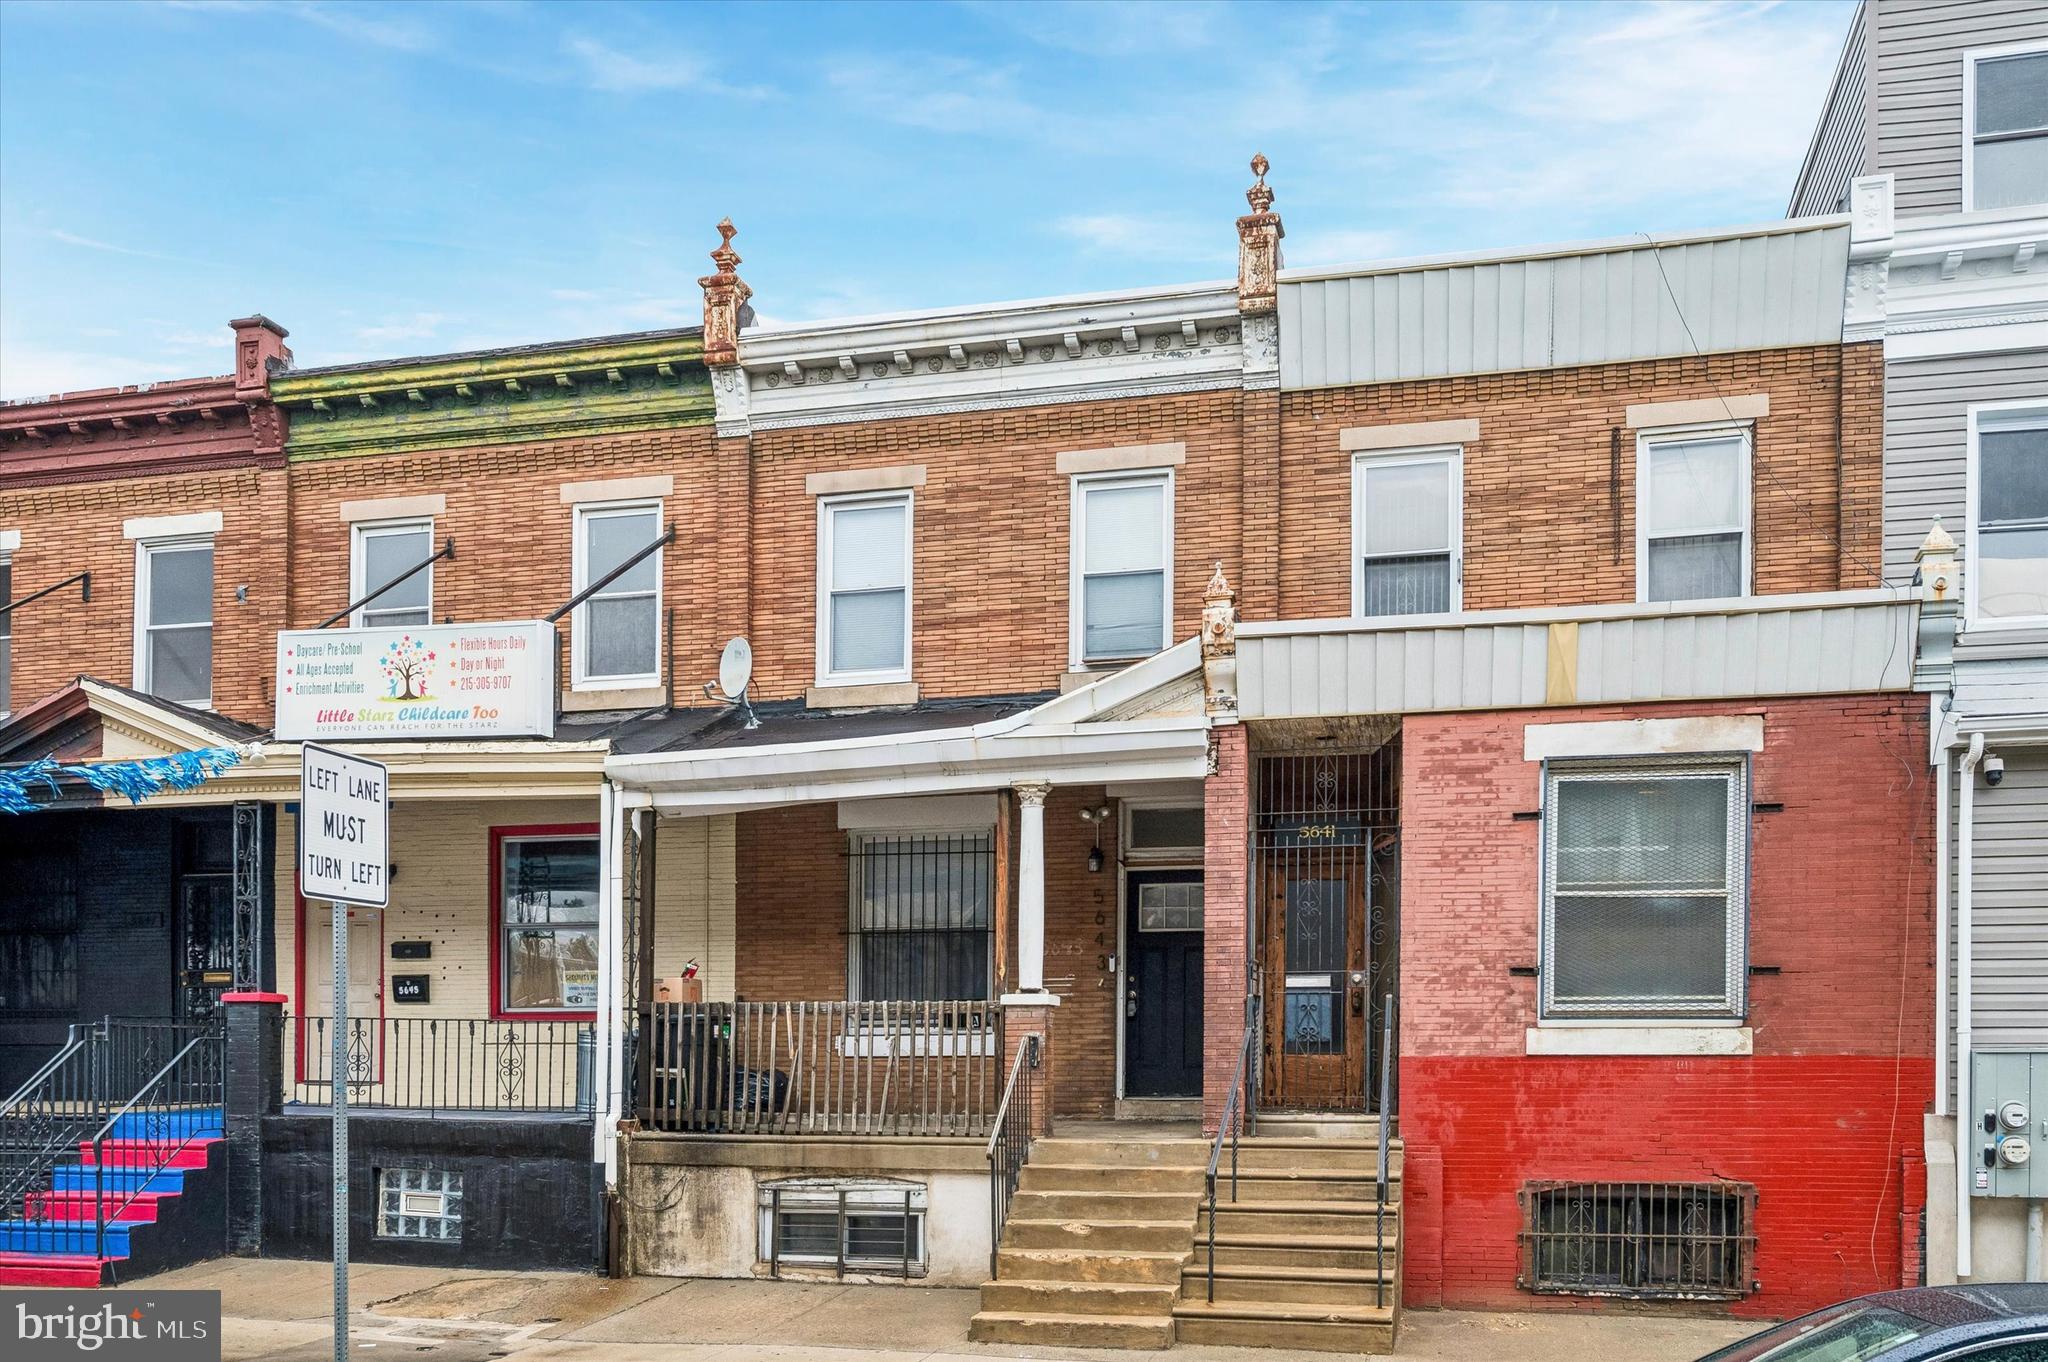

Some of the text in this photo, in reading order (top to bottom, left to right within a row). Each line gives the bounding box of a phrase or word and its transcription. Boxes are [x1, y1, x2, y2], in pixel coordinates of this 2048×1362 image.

[327, 642, 363, 656] Pre-School
[461, 635, 526, 651] Flexible Hours Daily
[296, 661, 354, 677] All Ages Accepted
[461, 656, 505, 672] Day or Night
[295, 680, 365, 695] Enrichment Activities
[461, 675, 512, 690] 215-305-9707
[316, 704, 499, 723] Little Starz Childcare Too
[316, 724, 361, 732] EVERYONE
[390, 723, 419, 731] REACH
[469, 721, 499, 729] STARZ
[309, 764, 381, 803] LEFT LANE
[323, 810, 366, 844] MUST
[1299, 825, 1336, 839] 5641
[308, 853, 381, 886] TURN LEFT
[1093, 888, 1106, 971] 5643
[398, 985, 420, 995] 5645
